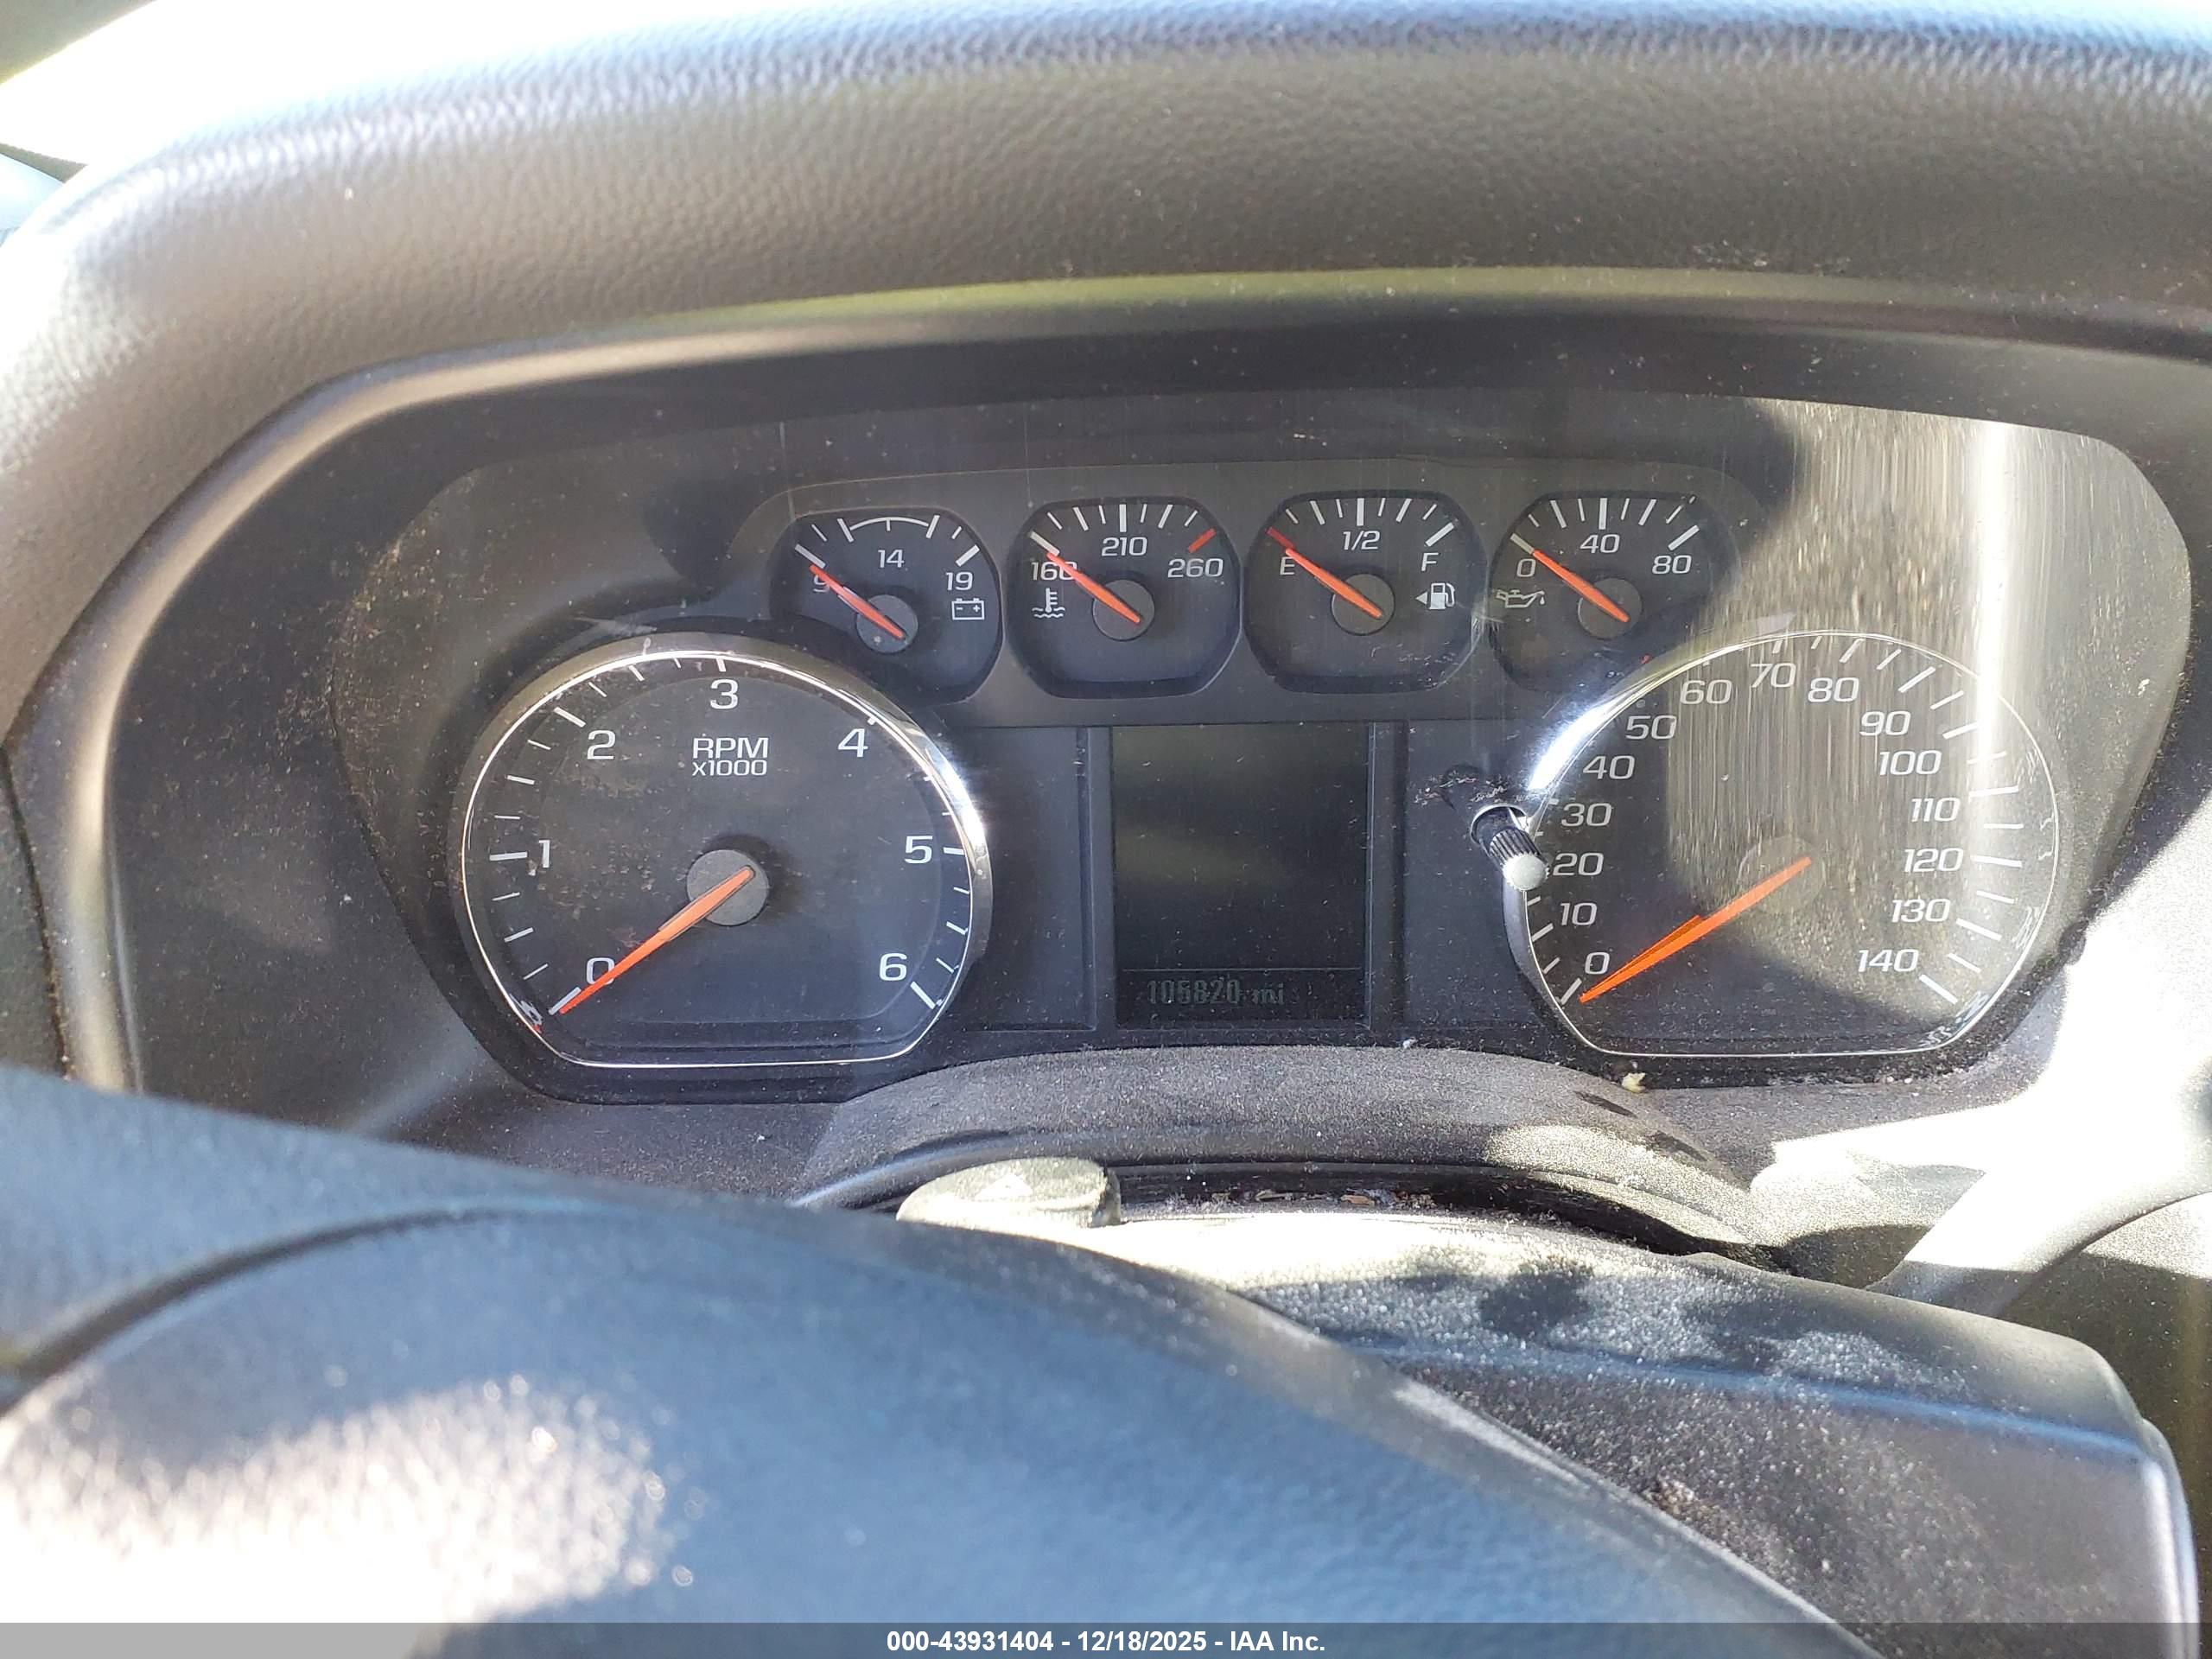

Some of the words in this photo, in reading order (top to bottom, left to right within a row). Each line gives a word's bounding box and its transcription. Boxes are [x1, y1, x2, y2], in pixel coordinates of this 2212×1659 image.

[1101, 537, 1147, 556] 210
[1343, 530, 1381, 550] 1/2
[1580, 534, 1620, 554] 40
[877, 549, 905, 569] 14
[1031, 561, 1077, 581] 160
[1167, 557, 1224, 578] 260
[1279, 556, 1296, 575] E
[1421, 552, 1440, 572] F
[1516, 558, 1536, 577] 0
[1651, 555, 1692, 575] 80
[945, 571, 973, 591] 19
[1750, 662, 1796, 688] 70
[709, 678, 739, 709] 3
[1679, 679, 1732, 705] 60
[1808, 677, 1859, 702] 80
[1625, 715, 1677, 740] 50
[1859, 710, 1911, 736] 90
[587, 729, 616, 760] 2
[692, 737, 769, 759] RPM
[837, 728, 868, 758] 4
[691, 760, 767, 776] x1000
[1582, 754, 1636, 779] 40
[1878, 749, 1942, 775] 100
[1560, 803, 1612, 827] 30
[1910, 798, 1961, 822] 110
[538, 839, 550, 868] 1
[904, 835, 933, 864] 5
[1904, 848, 1964, 872] 120
[1553, 852, 1605, 876] 20
[1560, 902, 1598, 926] 10
[1891, 898, 1951, 922] 130
[586, 957, 615, 985] 0
[879, 952, 907, 982] 6
[1584, 951, 1610, 975] 0
[1858, 948, 1920, 972] 140
[1253, 982, 1285, 1004] mi
